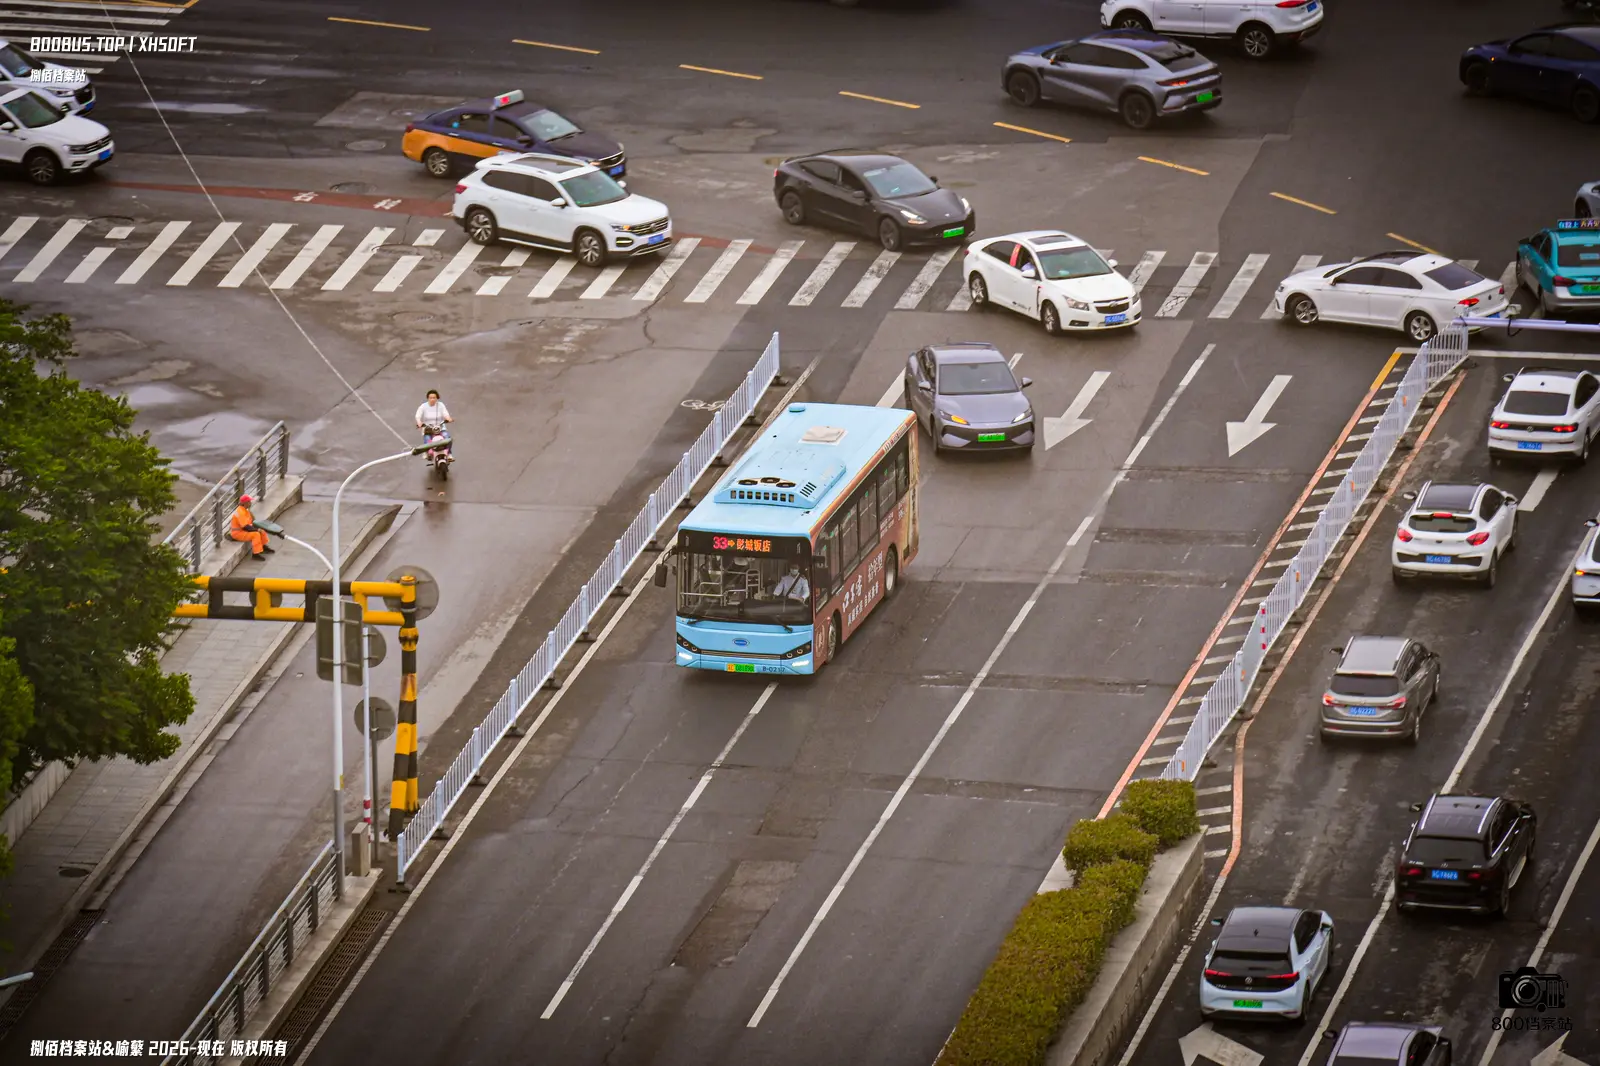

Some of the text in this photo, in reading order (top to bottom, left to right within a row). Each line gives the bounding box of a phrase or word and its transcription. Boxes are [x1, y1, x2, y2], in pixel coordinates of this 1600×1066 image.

[712, 535, 771, 552] 33 彭城饭店
